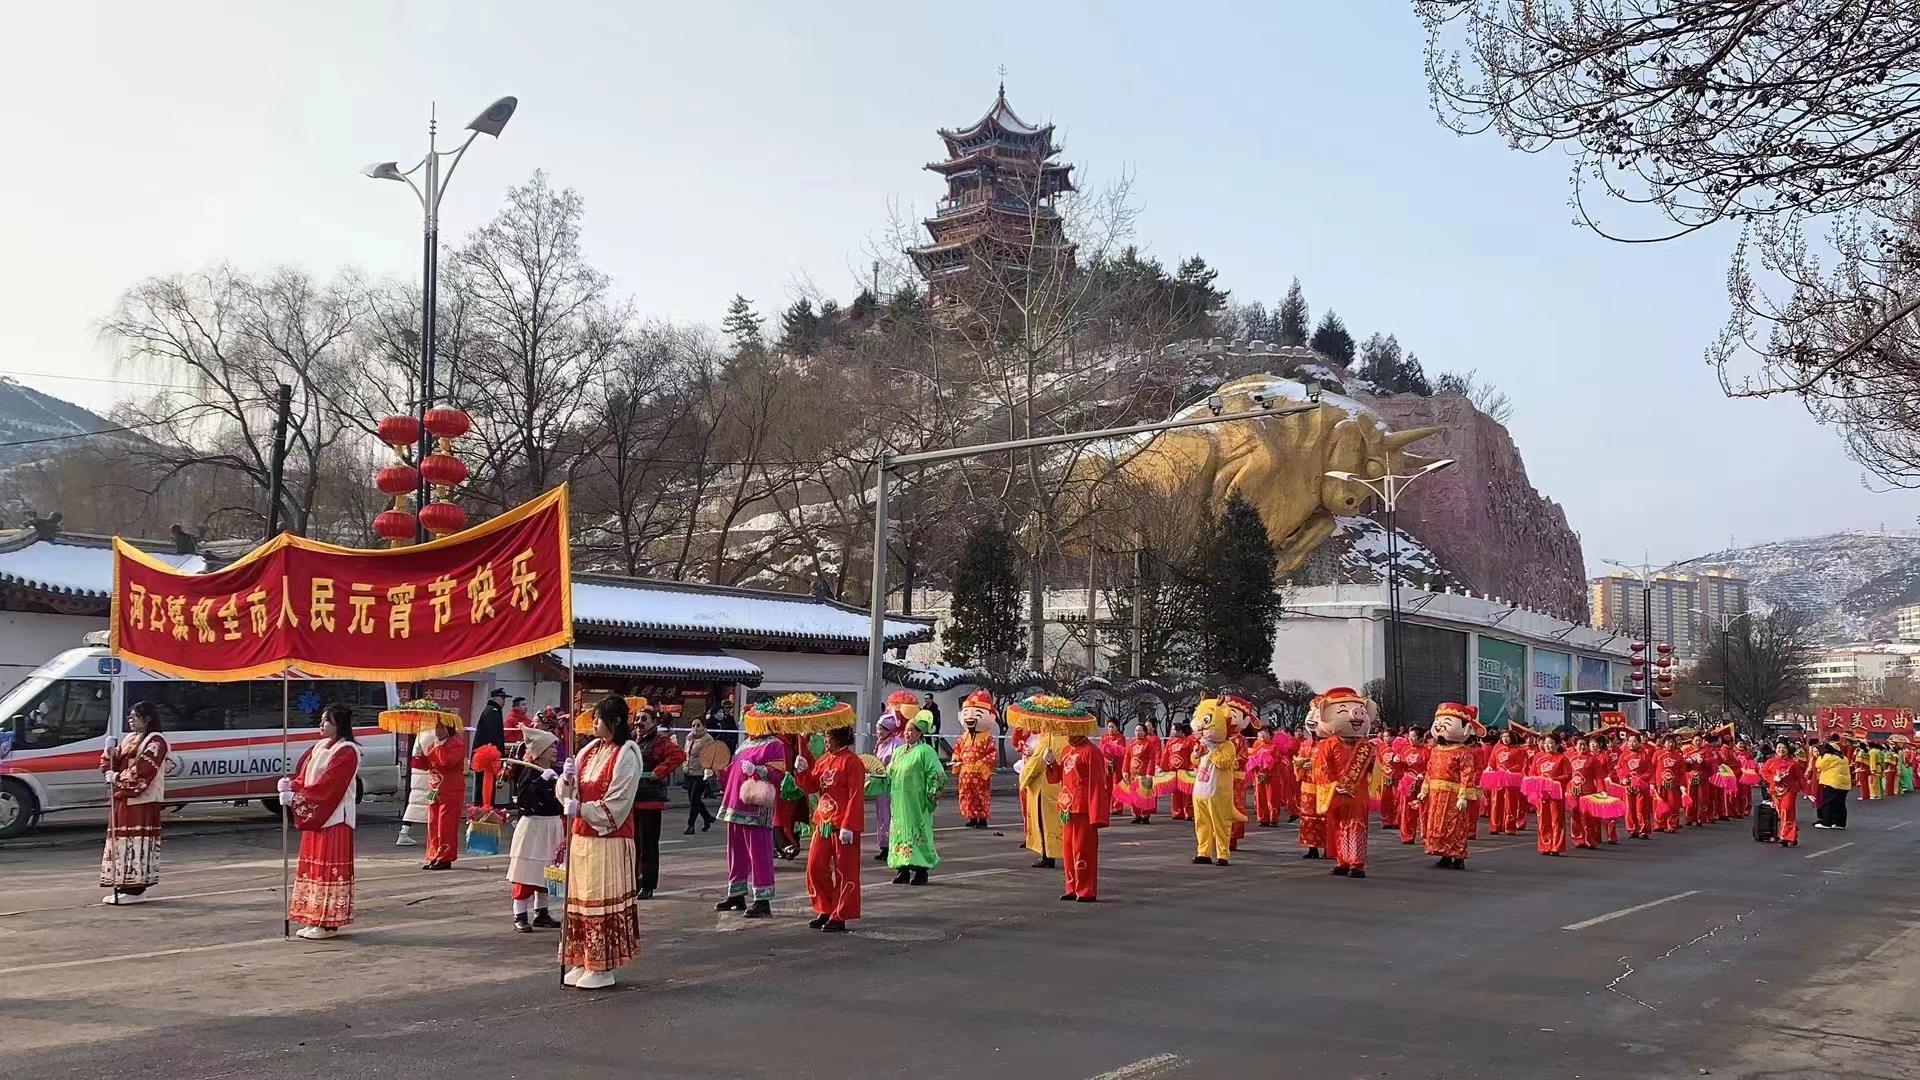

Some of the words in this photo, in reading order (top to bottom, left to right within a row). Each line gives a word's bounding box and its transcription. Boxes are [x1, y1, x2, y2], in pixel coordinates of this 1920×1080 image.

[129, 547, 540, 643] 河口镇祝全市人民元宵节快乐
[1828, 712, 1908, 730] 大美西曲
[189, 757, 291, 776] AMBULANCE
